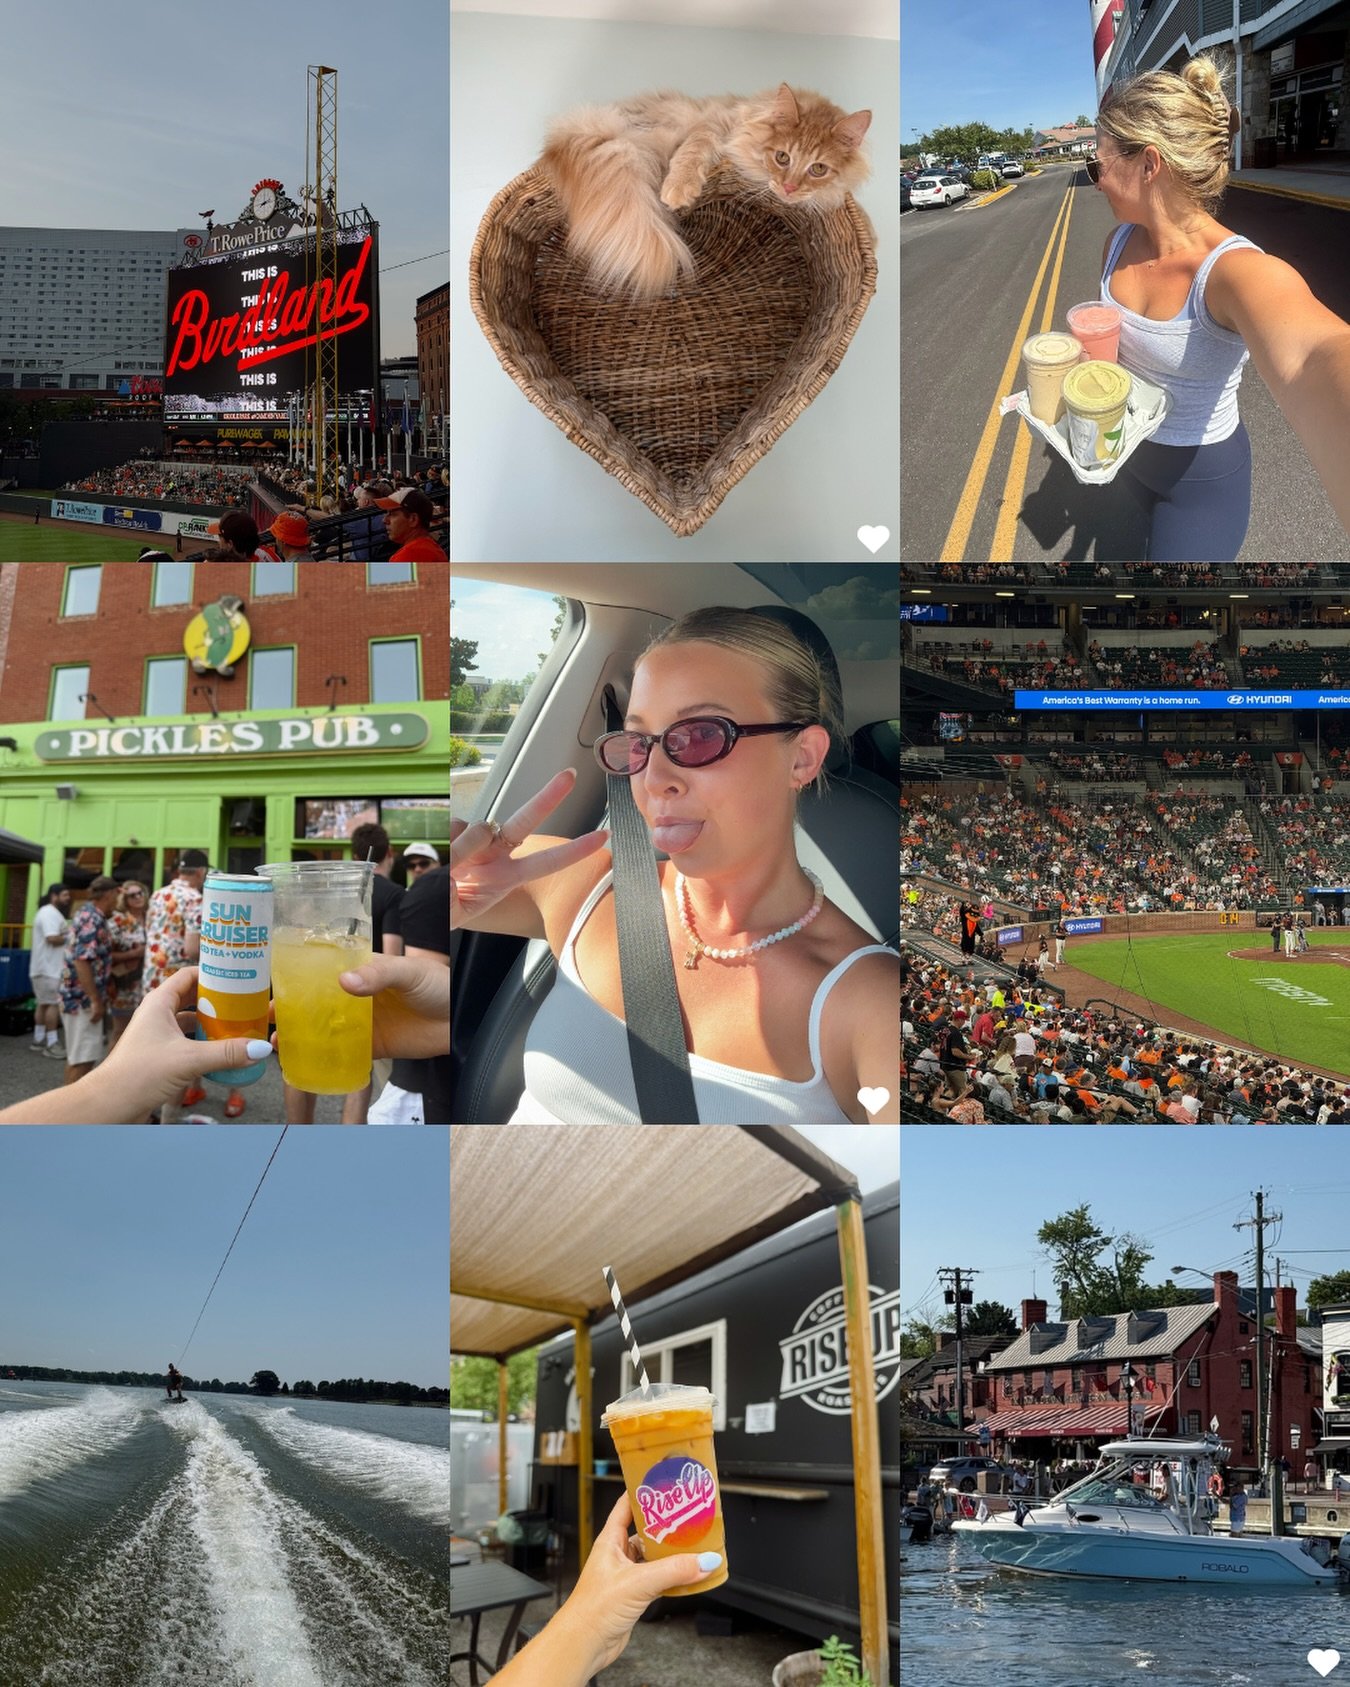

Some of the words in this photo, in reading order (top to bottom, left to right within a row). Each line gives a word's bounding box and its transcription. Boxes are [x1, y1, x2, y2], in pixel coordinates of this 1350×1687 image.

[241, 268, 266, 282] THIS
[267, 266, 278, 278] IS
[166, 235, 372, 377] Birdland
[241, 294, 265, 307] THI
[240, 374, 264, 386] THIS
[266, 373, 277, 385] IS
[240, 401, 264, 411] THIS
[266, 400, 277, 410] IS
[1042, 696, 1083, 705] America's
[1085, 696, 1103, 705] Best
[1104, 696, 1142, 706] Warranty
[1143, 696, 1151, 705] is
[1159, 696, 1183, 705] home
[1184, 697, 1201, 705] run.
[1246, 695, 1292, 704] HYUNDAI
[68, 721, 264, 756] PICKLES
[278, 716, 380, 749] PUB
[209, 902, 251, 924] SUN
[210, 948, 224, 957] TEA
[231, 951, 264, 959] VODKA
[809, 1294, 845, 1322] COFF
[636, 1485, 683, 1526] Rise
[679, 1463, 716, 1503] Up
[1201, 1562, 1249, 1573] ROBALO
